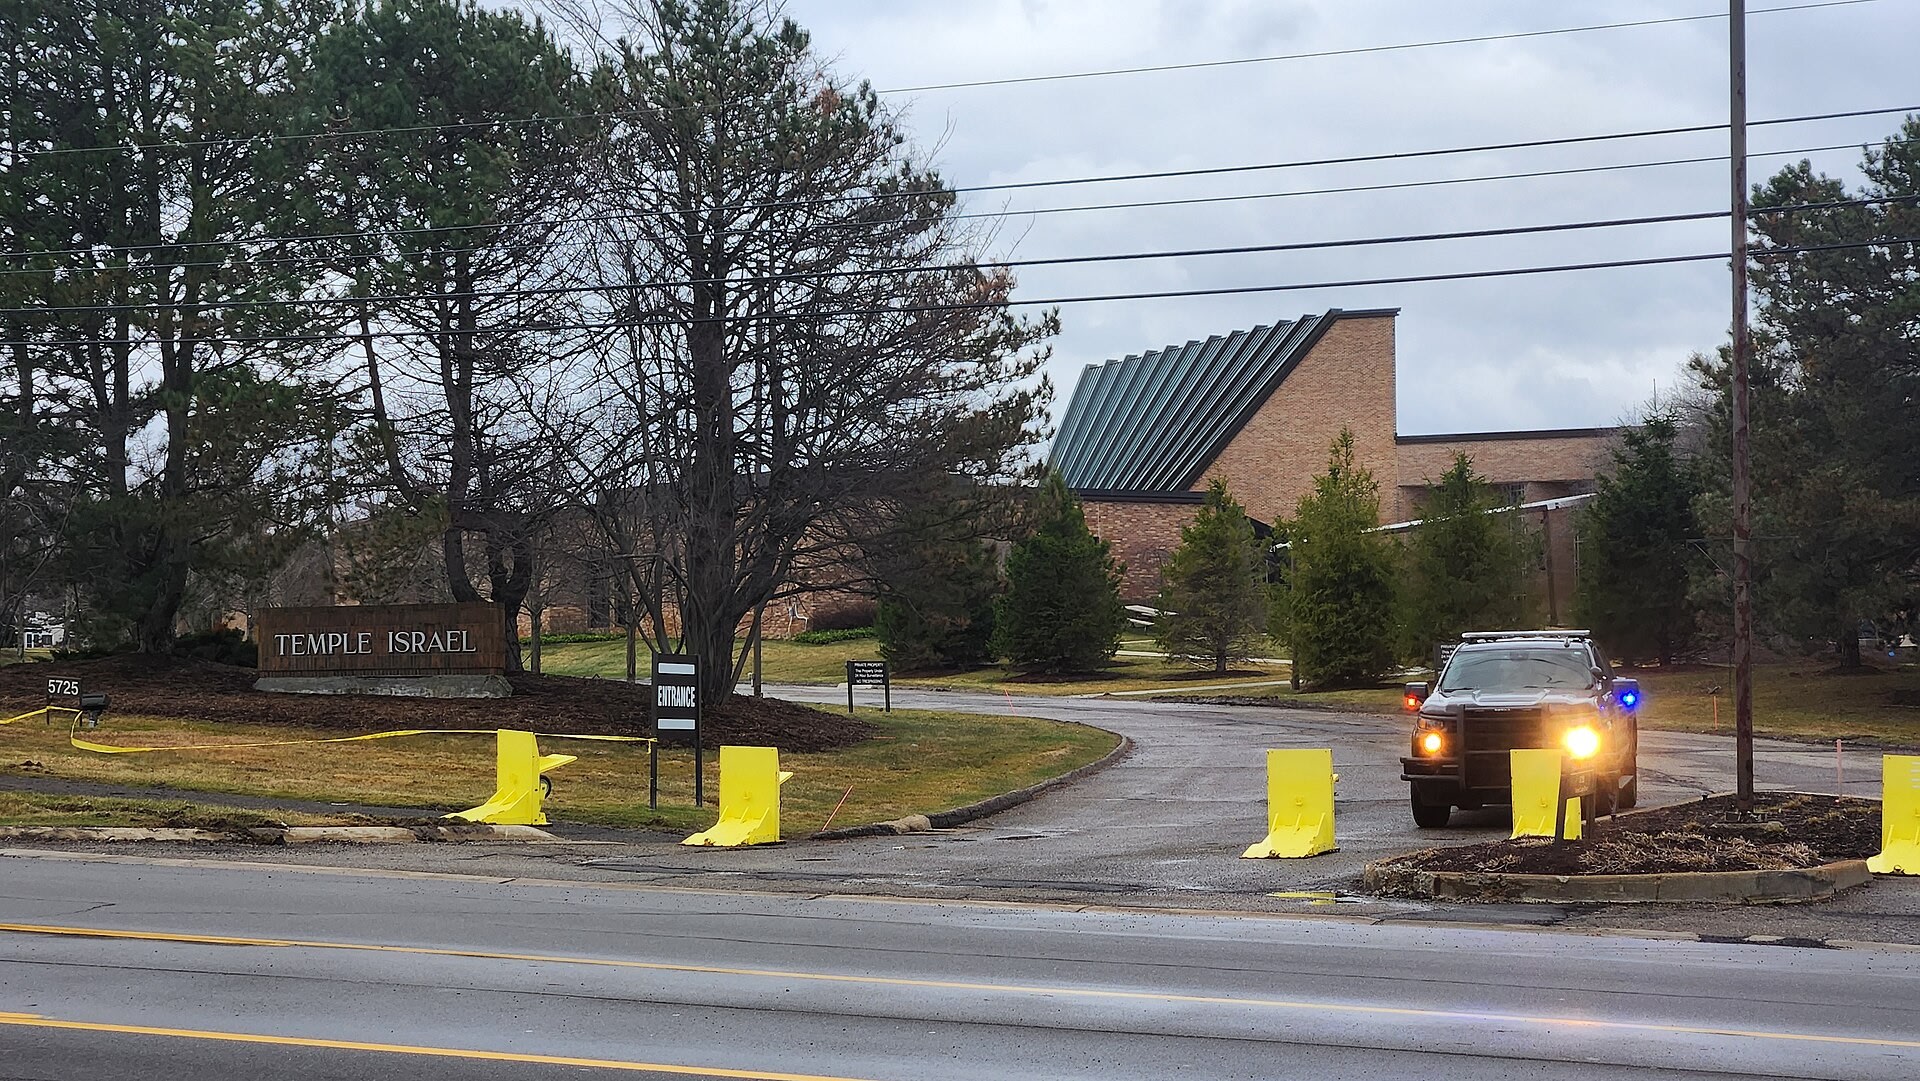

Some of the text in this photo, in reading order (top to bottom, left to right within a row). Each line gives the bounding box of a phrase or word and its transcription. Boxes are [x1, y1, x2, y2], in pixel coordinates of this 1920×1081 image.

[274, 630, 477, 656] TEMPLE ISRAEL
[48, 680, 79, 695] 5725
[657, 685, 696, 707] ENTRANCE
